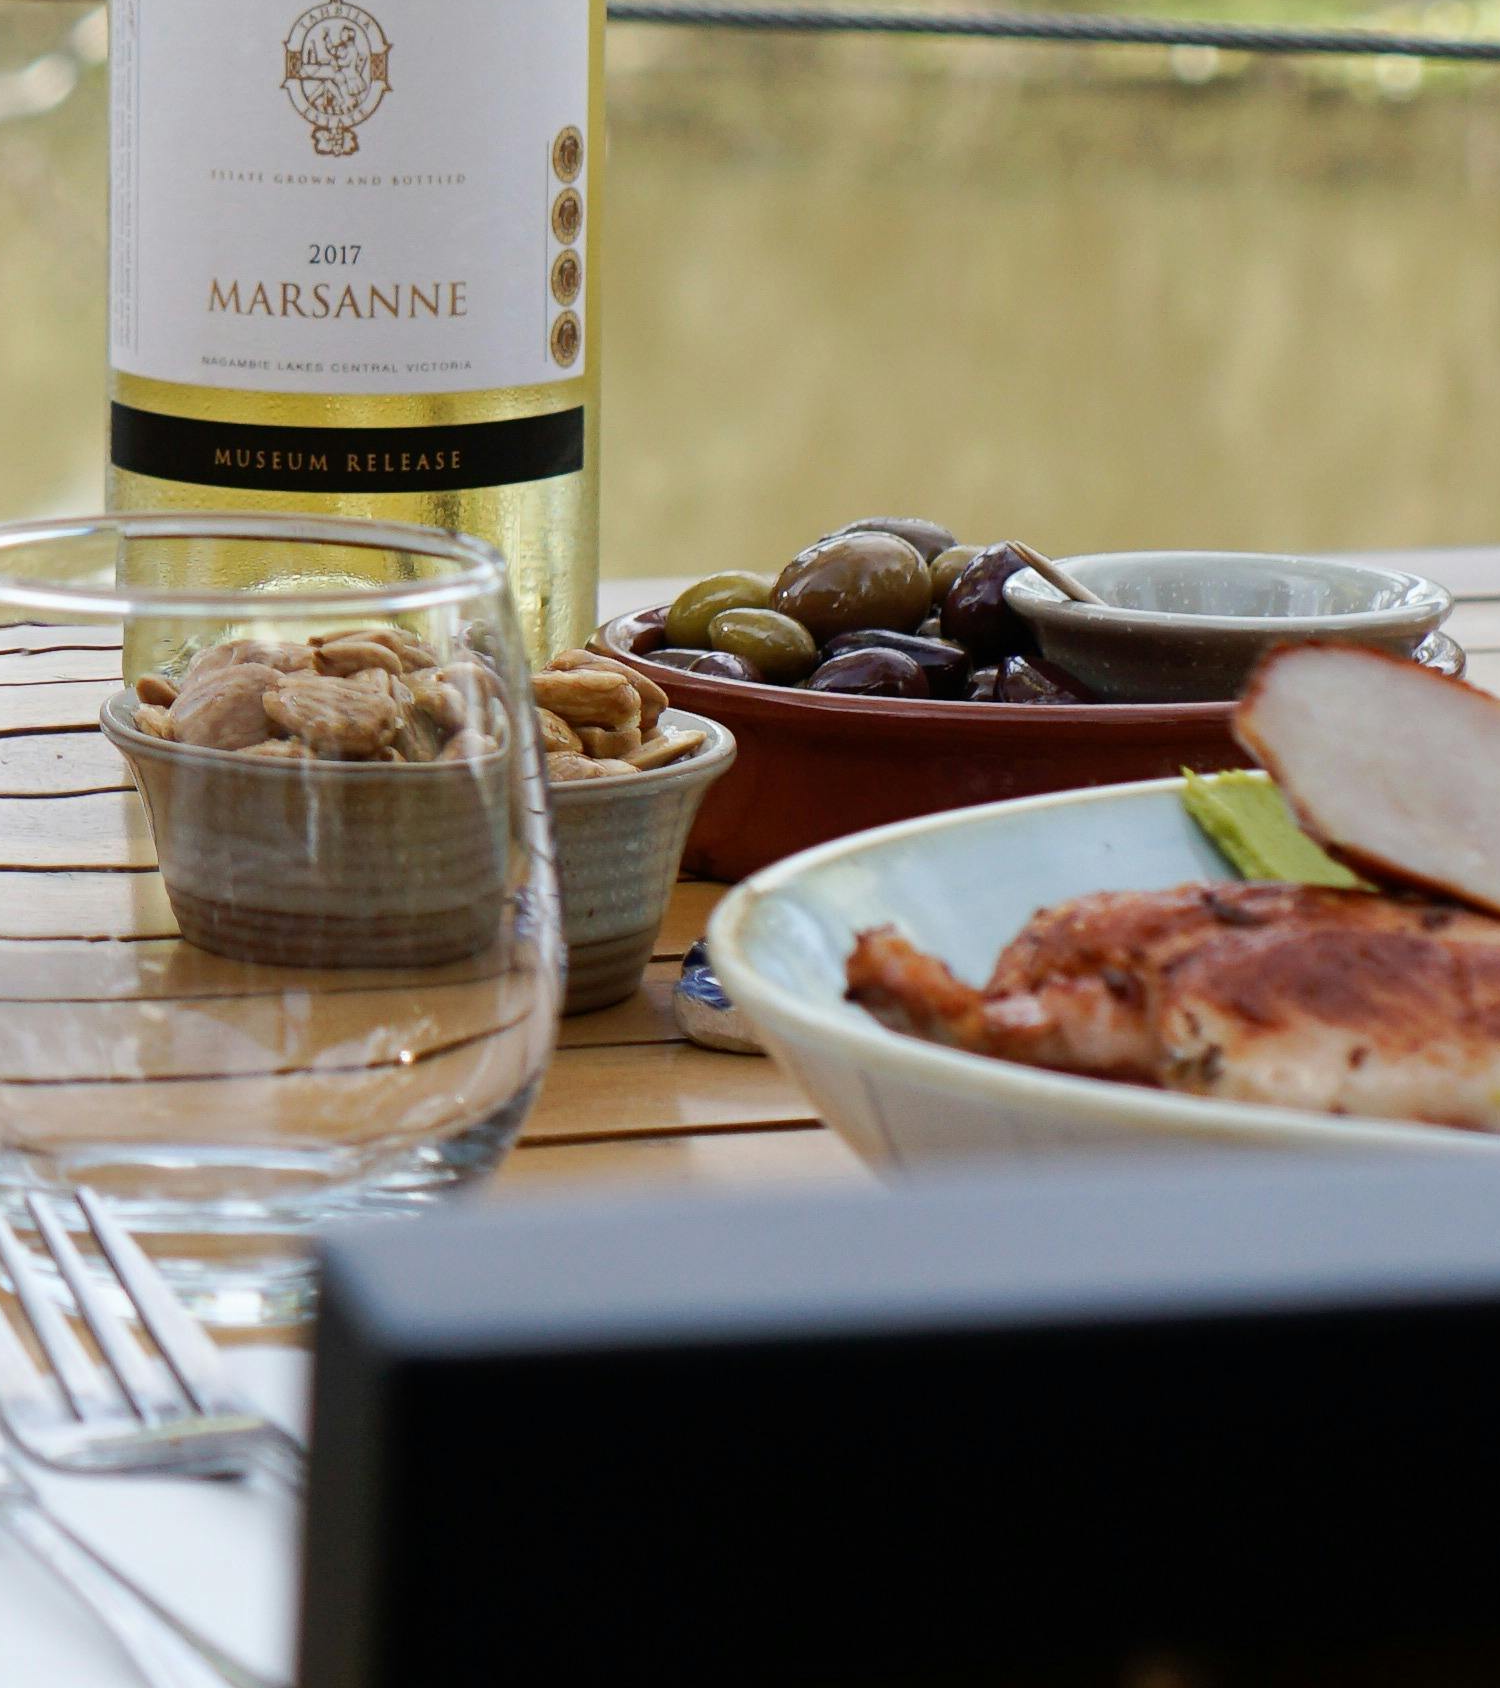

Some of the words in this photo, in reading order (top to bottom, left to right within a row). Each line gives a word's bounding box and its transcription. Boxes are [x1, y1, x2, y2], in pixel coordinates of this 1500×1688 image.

[274, 172, 337, 185] GROWN
[346, 174, 382, 186] AND
[392, 173, 467, 185] BOTTLED
[309, 244, 362, 265] 2017
[208, 277, 469, 319] MARSANNE
[201, 354, 271, 370] NAGAMBIE
[277, 360, 324, 373] LAKES
[331, 362, 399, 373] CENTRAL
[406, 360, 473, 373] VICTORIA
[214, 448, 328, 471] MUSEUM
[346, 450, 461, 472] RELEASE
